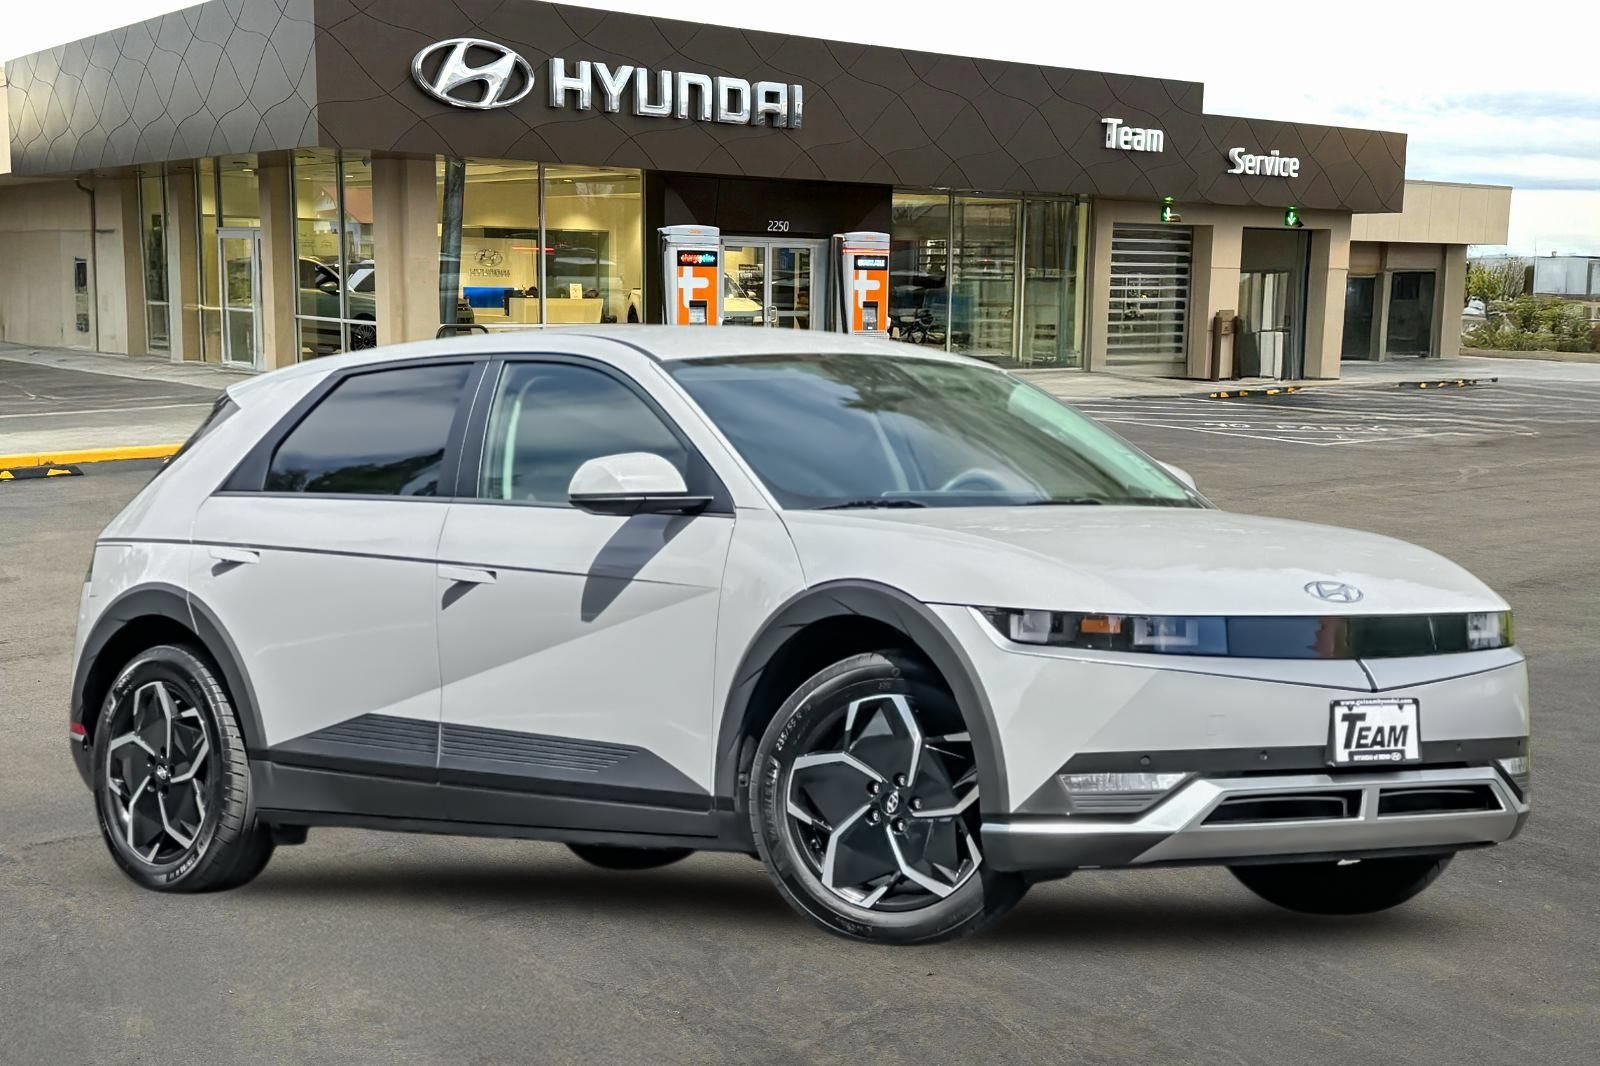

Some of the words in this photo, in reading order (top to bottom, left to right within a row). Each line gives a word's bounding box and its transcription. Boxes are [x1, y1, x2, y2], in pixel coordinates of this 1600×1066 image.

[549, 57, 803, 129] HYUNDAI
[1101, 117, 1164, 152] Team
[1227, 147, 1300, 178] Service
[767, 220, 790, 232] 2250
[1341, 712, 1409, 750] TEAM
